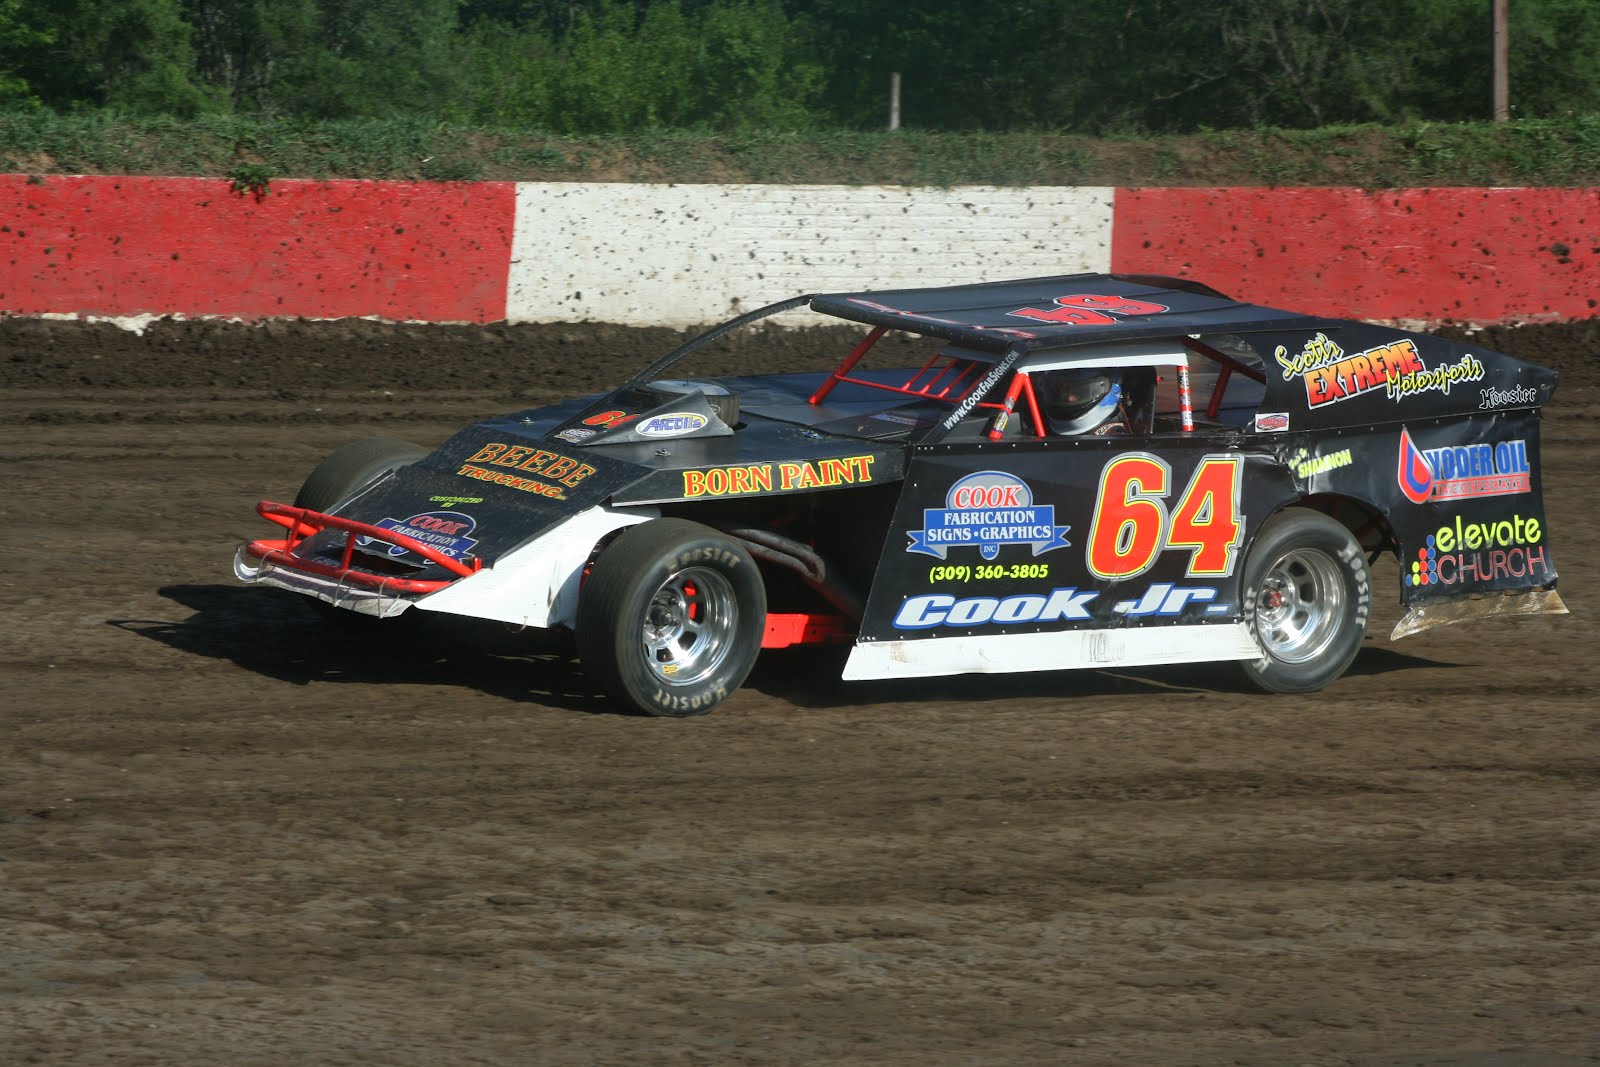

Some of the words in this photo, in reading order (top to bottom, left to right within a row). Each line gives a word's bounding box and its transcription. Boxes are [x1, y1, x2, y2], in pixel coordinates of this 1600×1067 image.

[1275, 332, 1343, 380] Scott's
[1304, 340, 1424, 408] EXTREME
[1385, 354, 1482, 400] Motorsports
[1479, 384, 1537, 409] Hoosier
[465, 443, 597, 488] BEEBE
[683, 467, 773, 497] BORN
[779, 455, 875, 489] PAINT
[1298, 448, 1352, 479] SHANNON
[1424, 444, 1494, 480] YODER
[1495, 440, 1529, 474] OIL
[457, 464, 563, 498] TRUCKING
[953, 484, 1024, 508] COOK
[410, 516, 469, 535] COOK
[927, 526, 972, 542] SIGNS
[977, 524, 1052, 541] GRAPHICS
[944, 509, 1036, 525] FABRICATION
[1086, 451, 1246, 581] 64
[1436, 515, 1541, 552] elevate
[388, 525, 459, 546] FABRICATION
[983, 545, 996, 553] INC
[929, 566, 970, 583] (309)
[975, 564, 1049, 580] 360-3805
[1437, 546, 1548, 584] CHURCH
[893, 586, 1100, 629] Cook
[1113, 582, 1233, 617] Jr.
